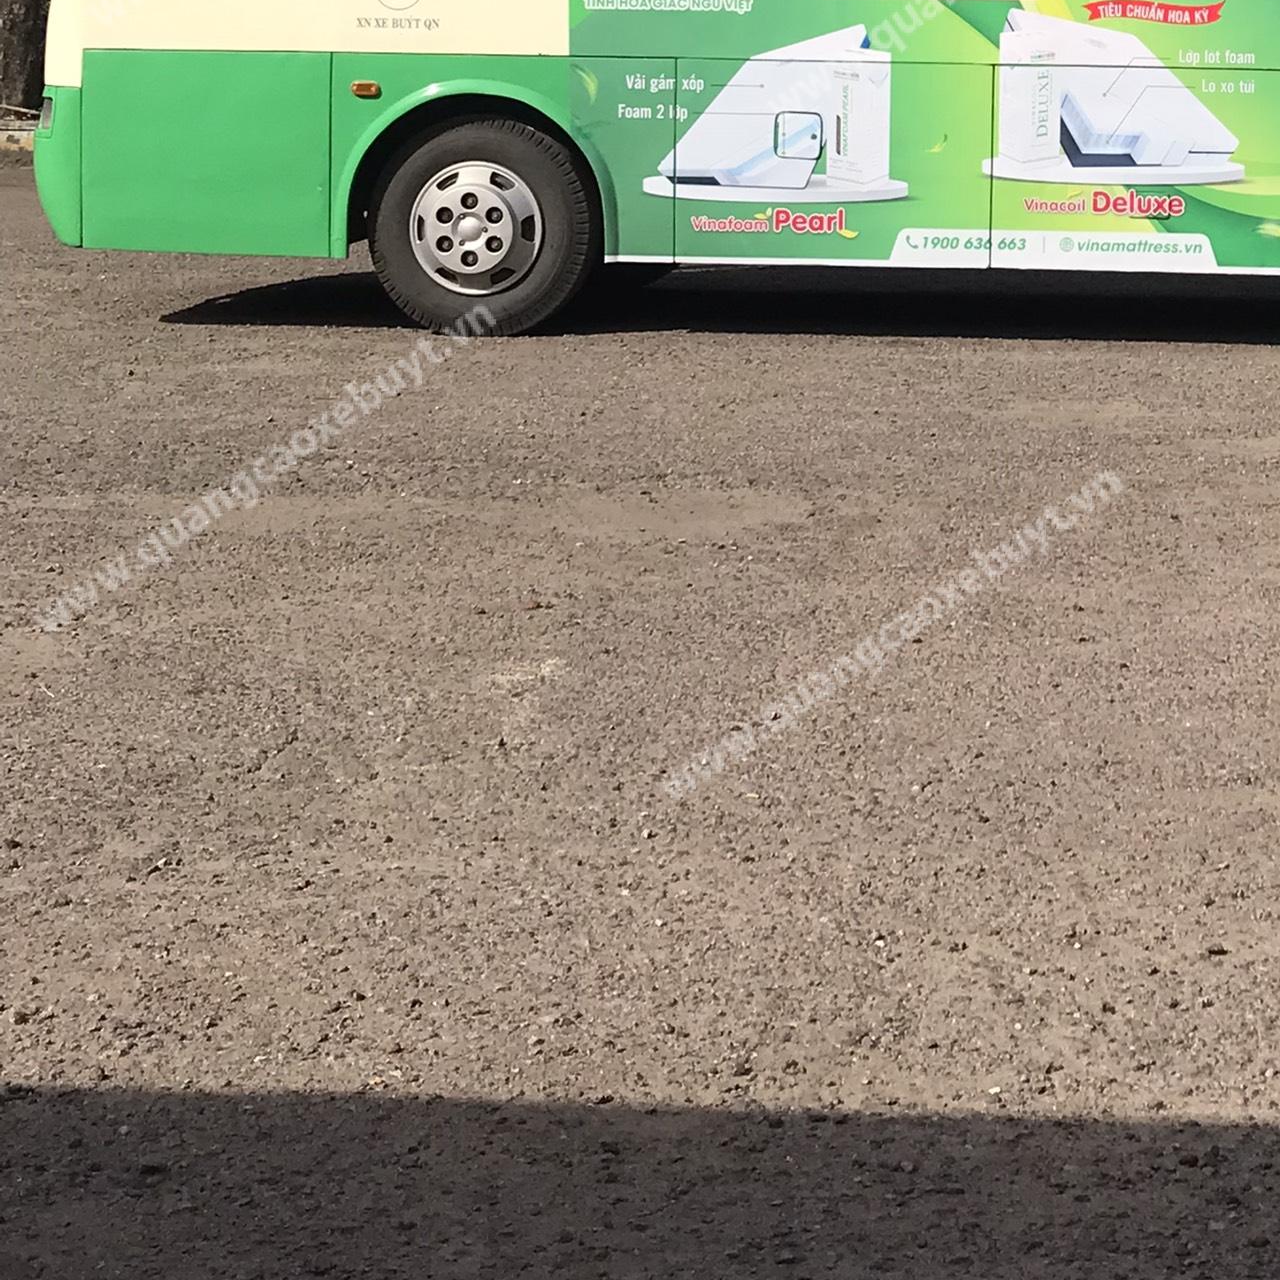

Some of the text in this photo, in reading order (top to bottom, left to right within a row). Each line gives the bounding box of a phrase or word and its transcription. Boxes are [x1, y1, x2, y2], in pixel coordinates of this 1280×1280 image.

[356, 17, 371, 28] XN
[374, 17, 388, 28] XE
[423, 18, 440, 31] QN
[1168, 10, 1190, 23] HOA
[1225, 50, 1255, 64] foam
[625, 73, 646, 90] Vải
[617, 104, 652, 119] Foam
[656, 104, 665, 119] 2
[1023, 190, 1184, 216] Vinacoil Deluxe
[691, 206, 846, 234] Vinafoam Pearl
[922, 236, 1027, 253] 1900 636 663
[1077, 240, 1204, 255] vinamattress.vn
